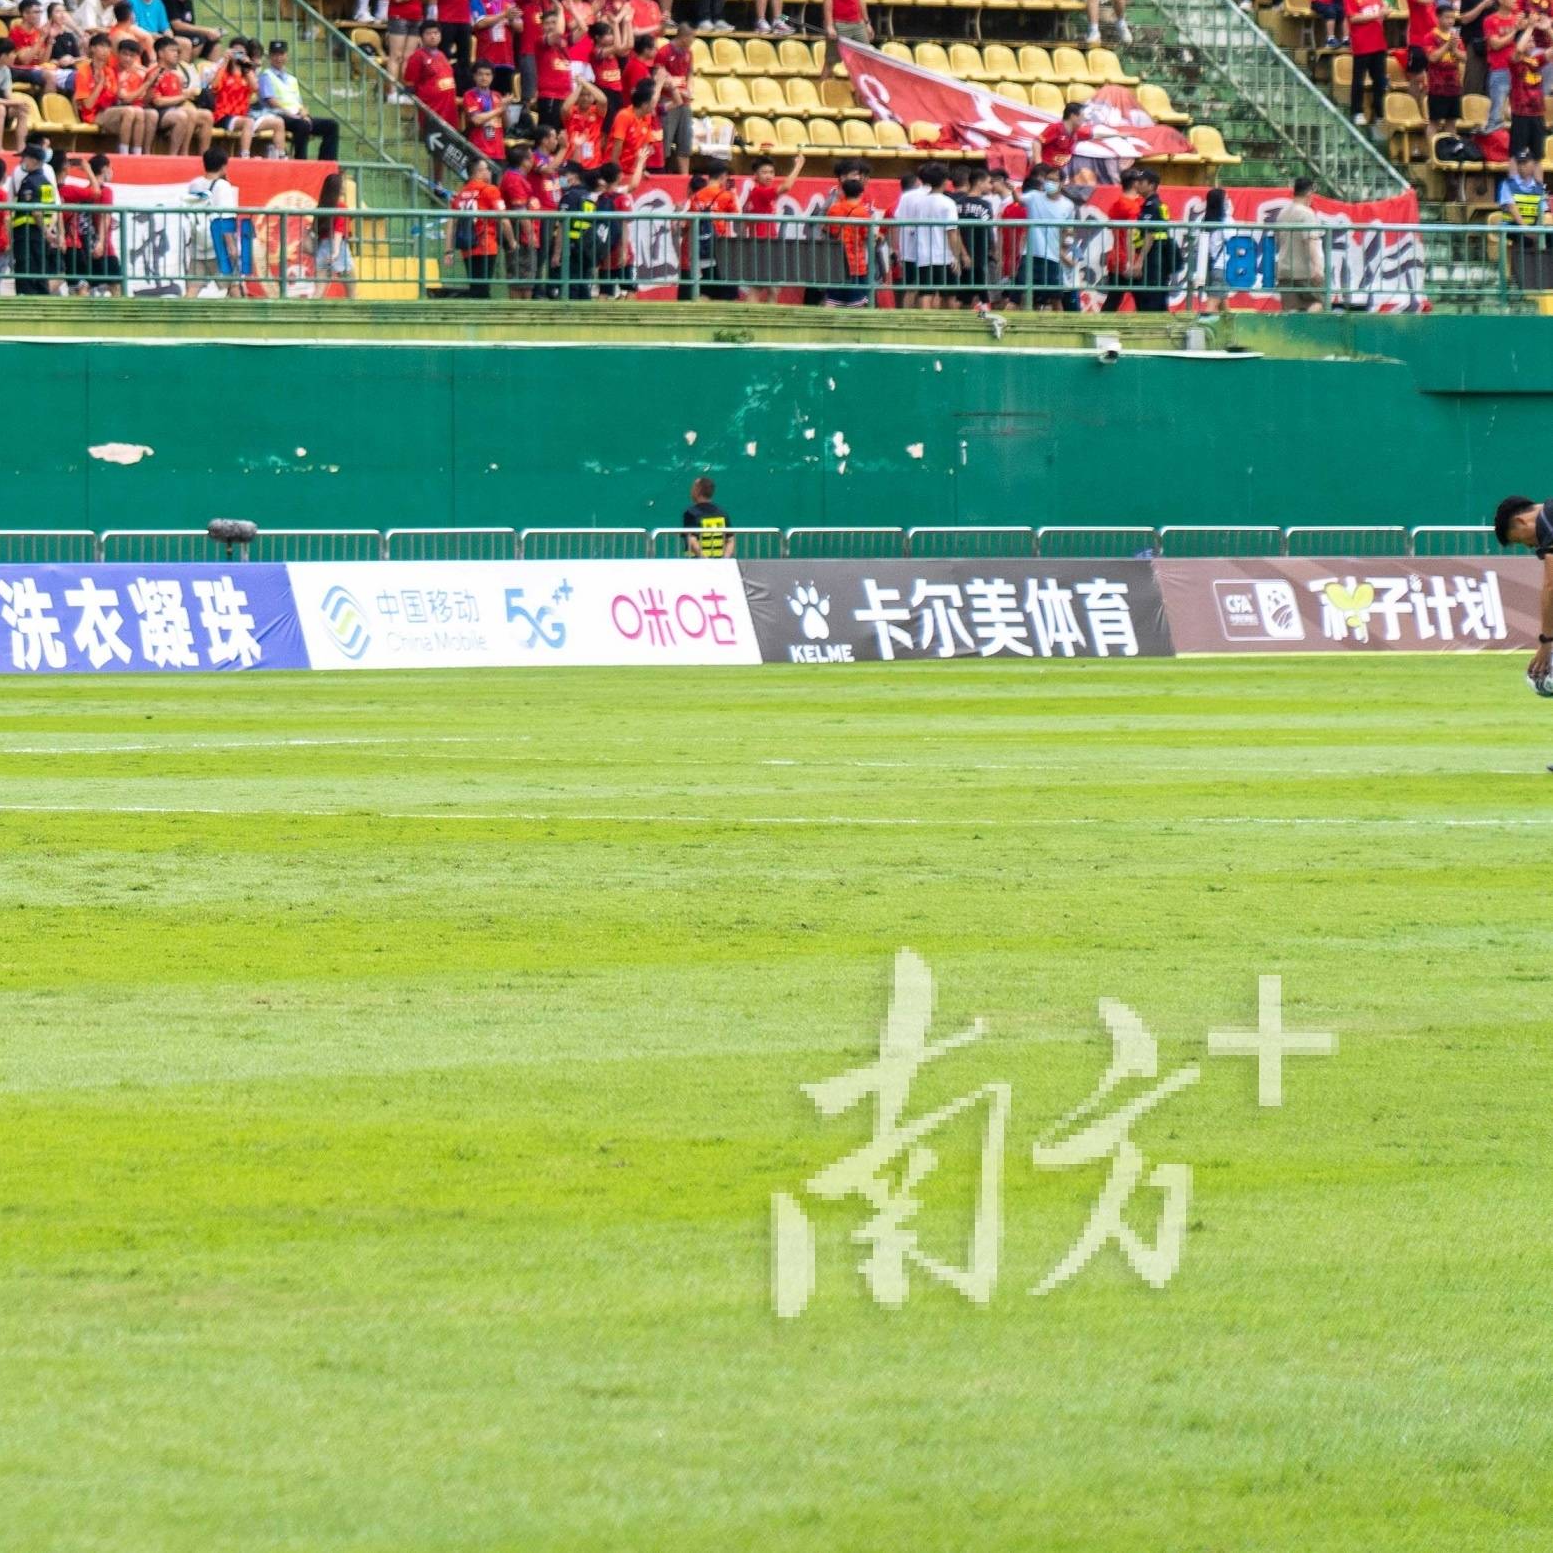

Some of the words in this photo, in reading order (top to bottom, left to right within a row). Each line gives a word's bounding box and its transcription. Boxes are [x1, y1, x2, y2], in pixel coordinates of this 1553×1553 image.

[376, 589, 481, 624] 中国移动
[612, 587, 738, 648] 咪咕
[853, 578, 1140, 660] 卡尔美体育
[789, 643, 855, 664] KELME
